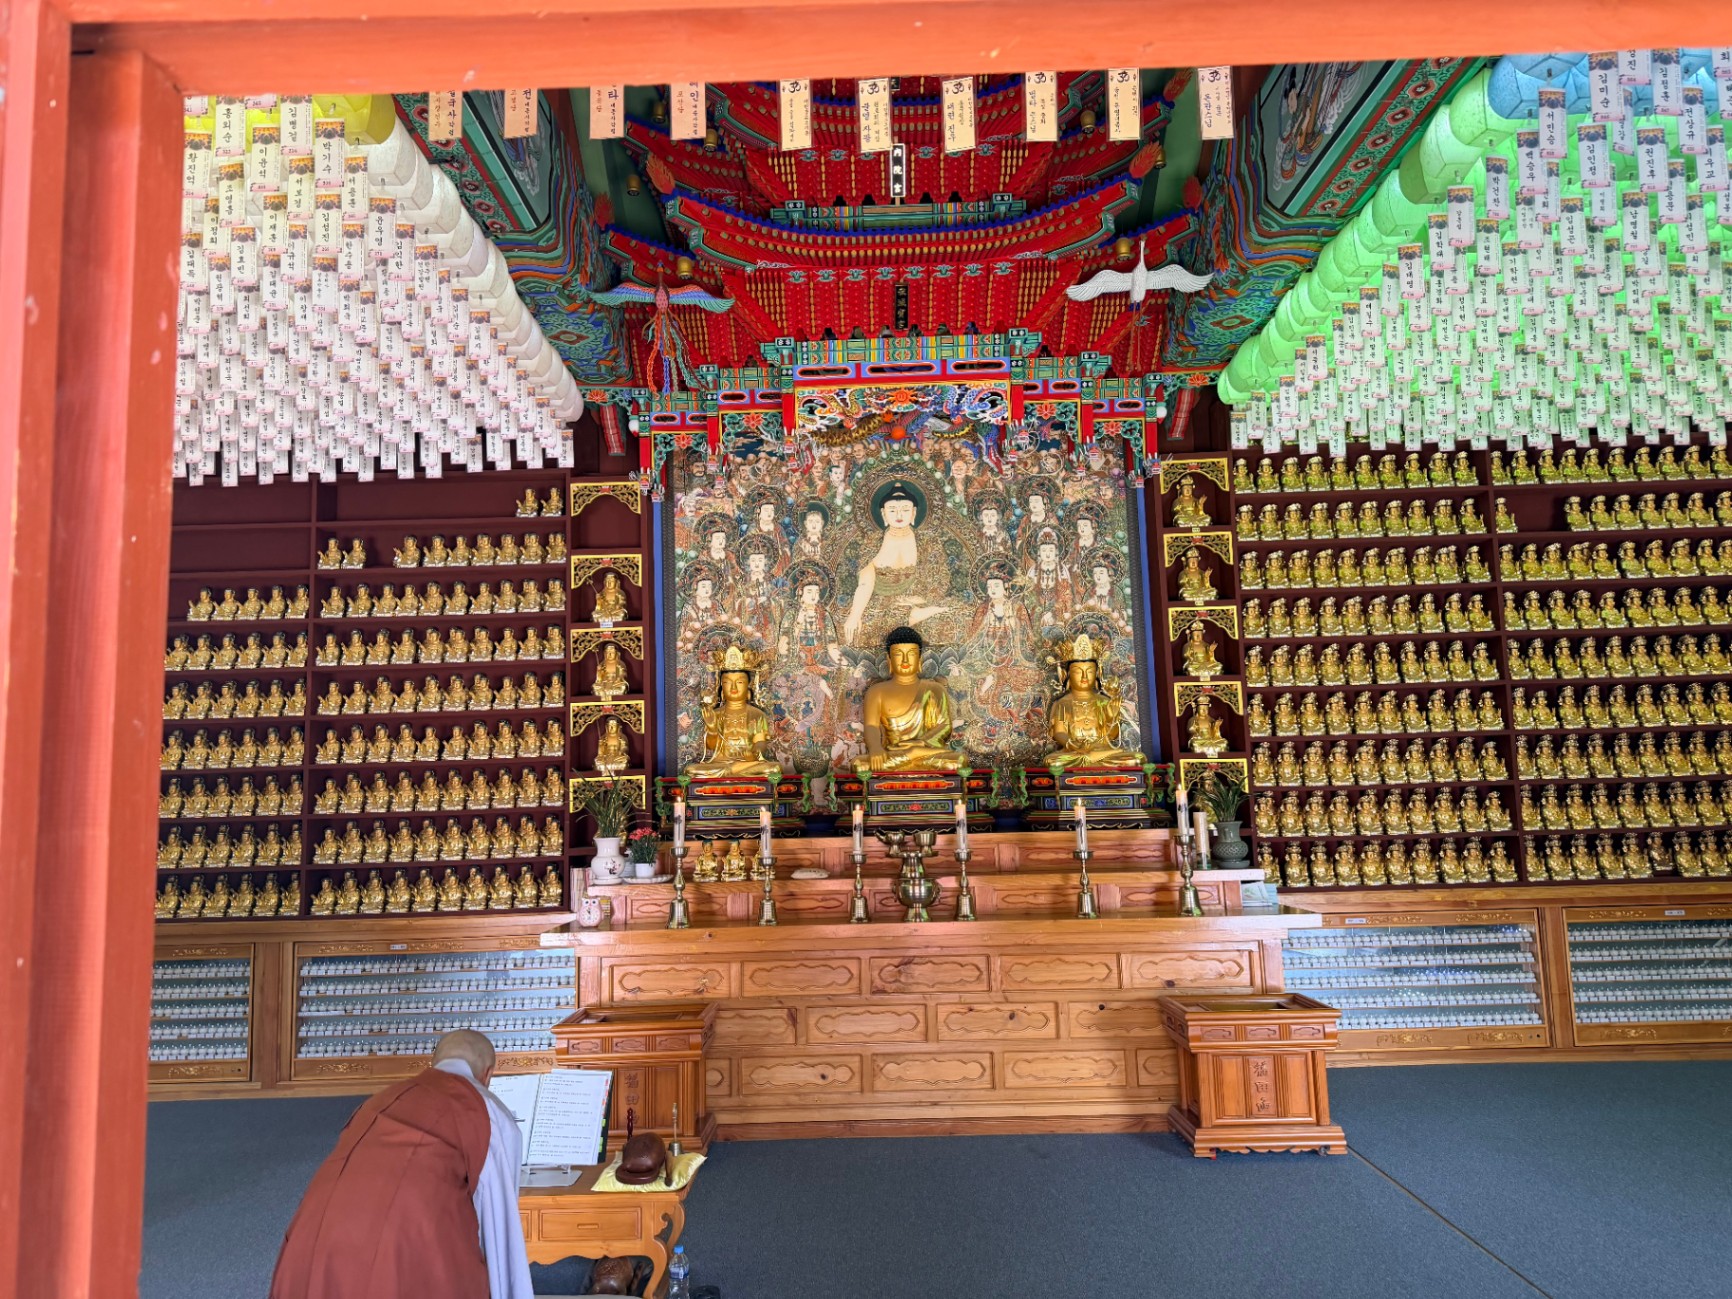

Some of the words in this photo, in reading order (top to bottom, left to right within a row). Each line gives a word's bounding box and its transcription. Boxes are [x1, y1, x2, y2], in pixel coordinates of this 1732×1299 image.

[1597, 72, 1611, 109] 김미순
[222, 107, 233, 144] 홍외순
[1544, 110, 1555, 145] 서민승
[186, 152, 198, 185] 황진억
[322, 141, 333, 175] 박기수
[1524, 150, 1536, 182] 백승우
